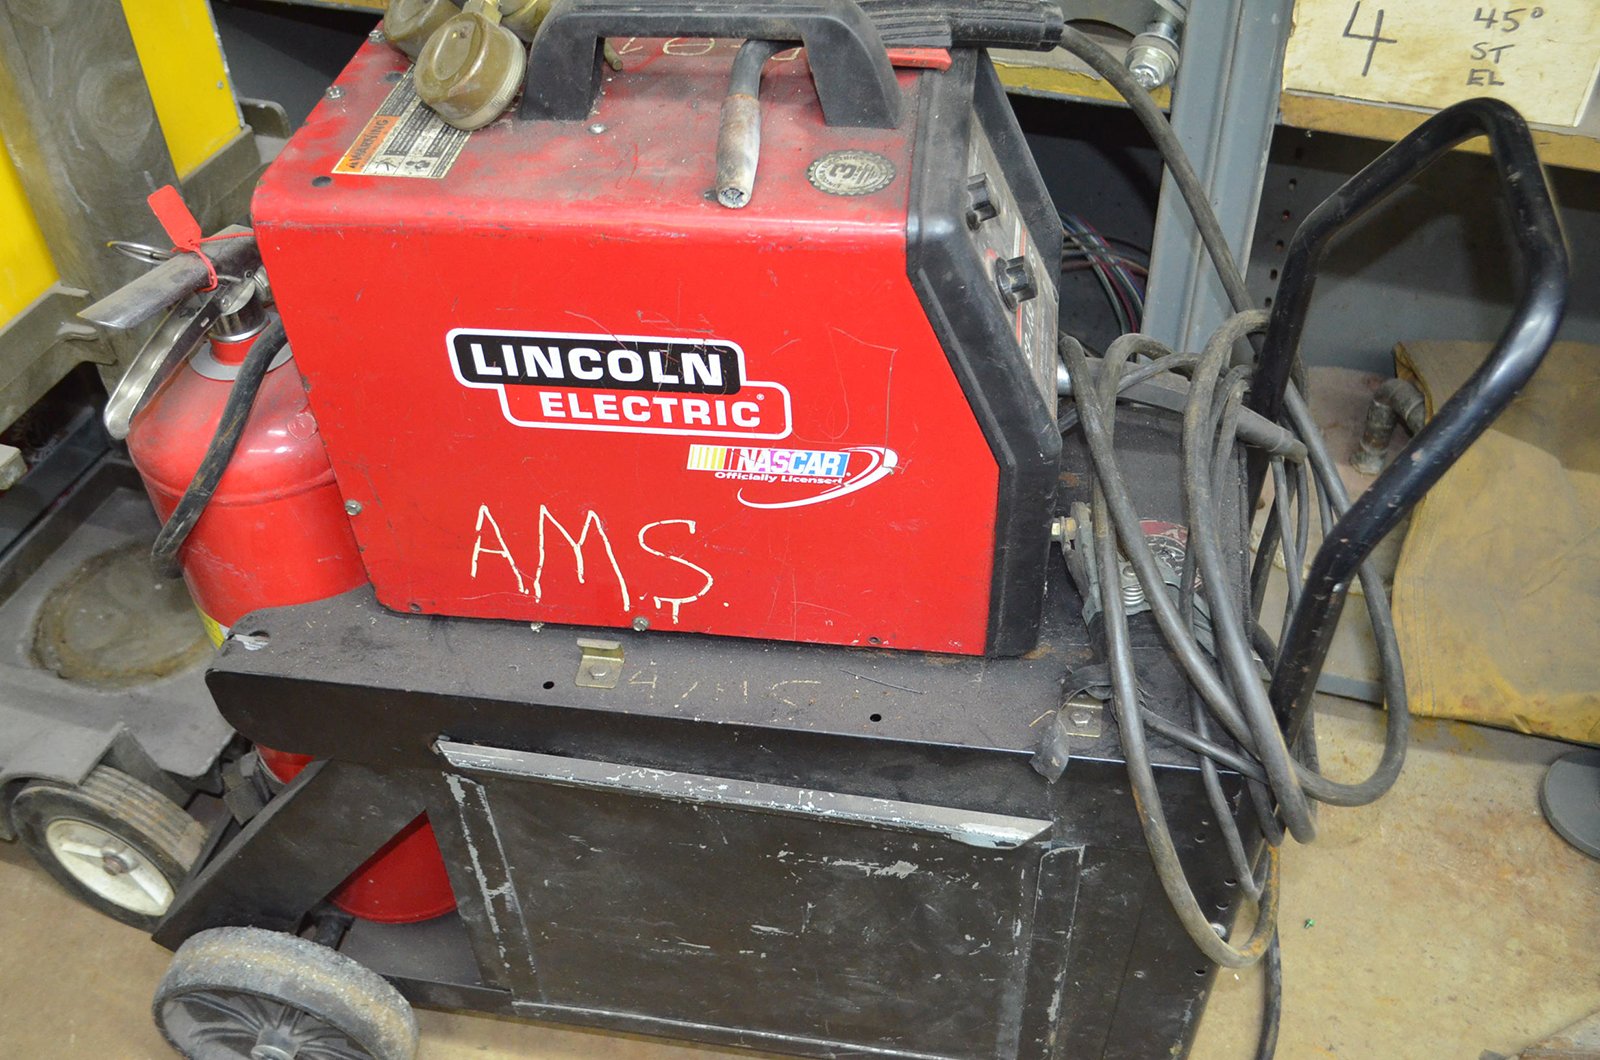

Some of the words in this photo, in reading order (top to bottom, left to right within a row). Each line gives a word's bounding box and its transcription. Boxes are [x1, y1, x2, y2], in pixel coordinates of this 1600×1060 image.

[1343, 1, 1397, 77] 4
[1471, 42, 1515, 64] ST
[1466, 69, 1505, 86] EL
[351, 119, 389, 161] WARNING
[469, 343, 723, 386] LINCOLN
[539, 391, 761, 427] ELECTRIC
[714, 471, 778, 483] Officially
[780, 475, 843, 485] Licensed
[737, 448, 842, 477] NASCAR
